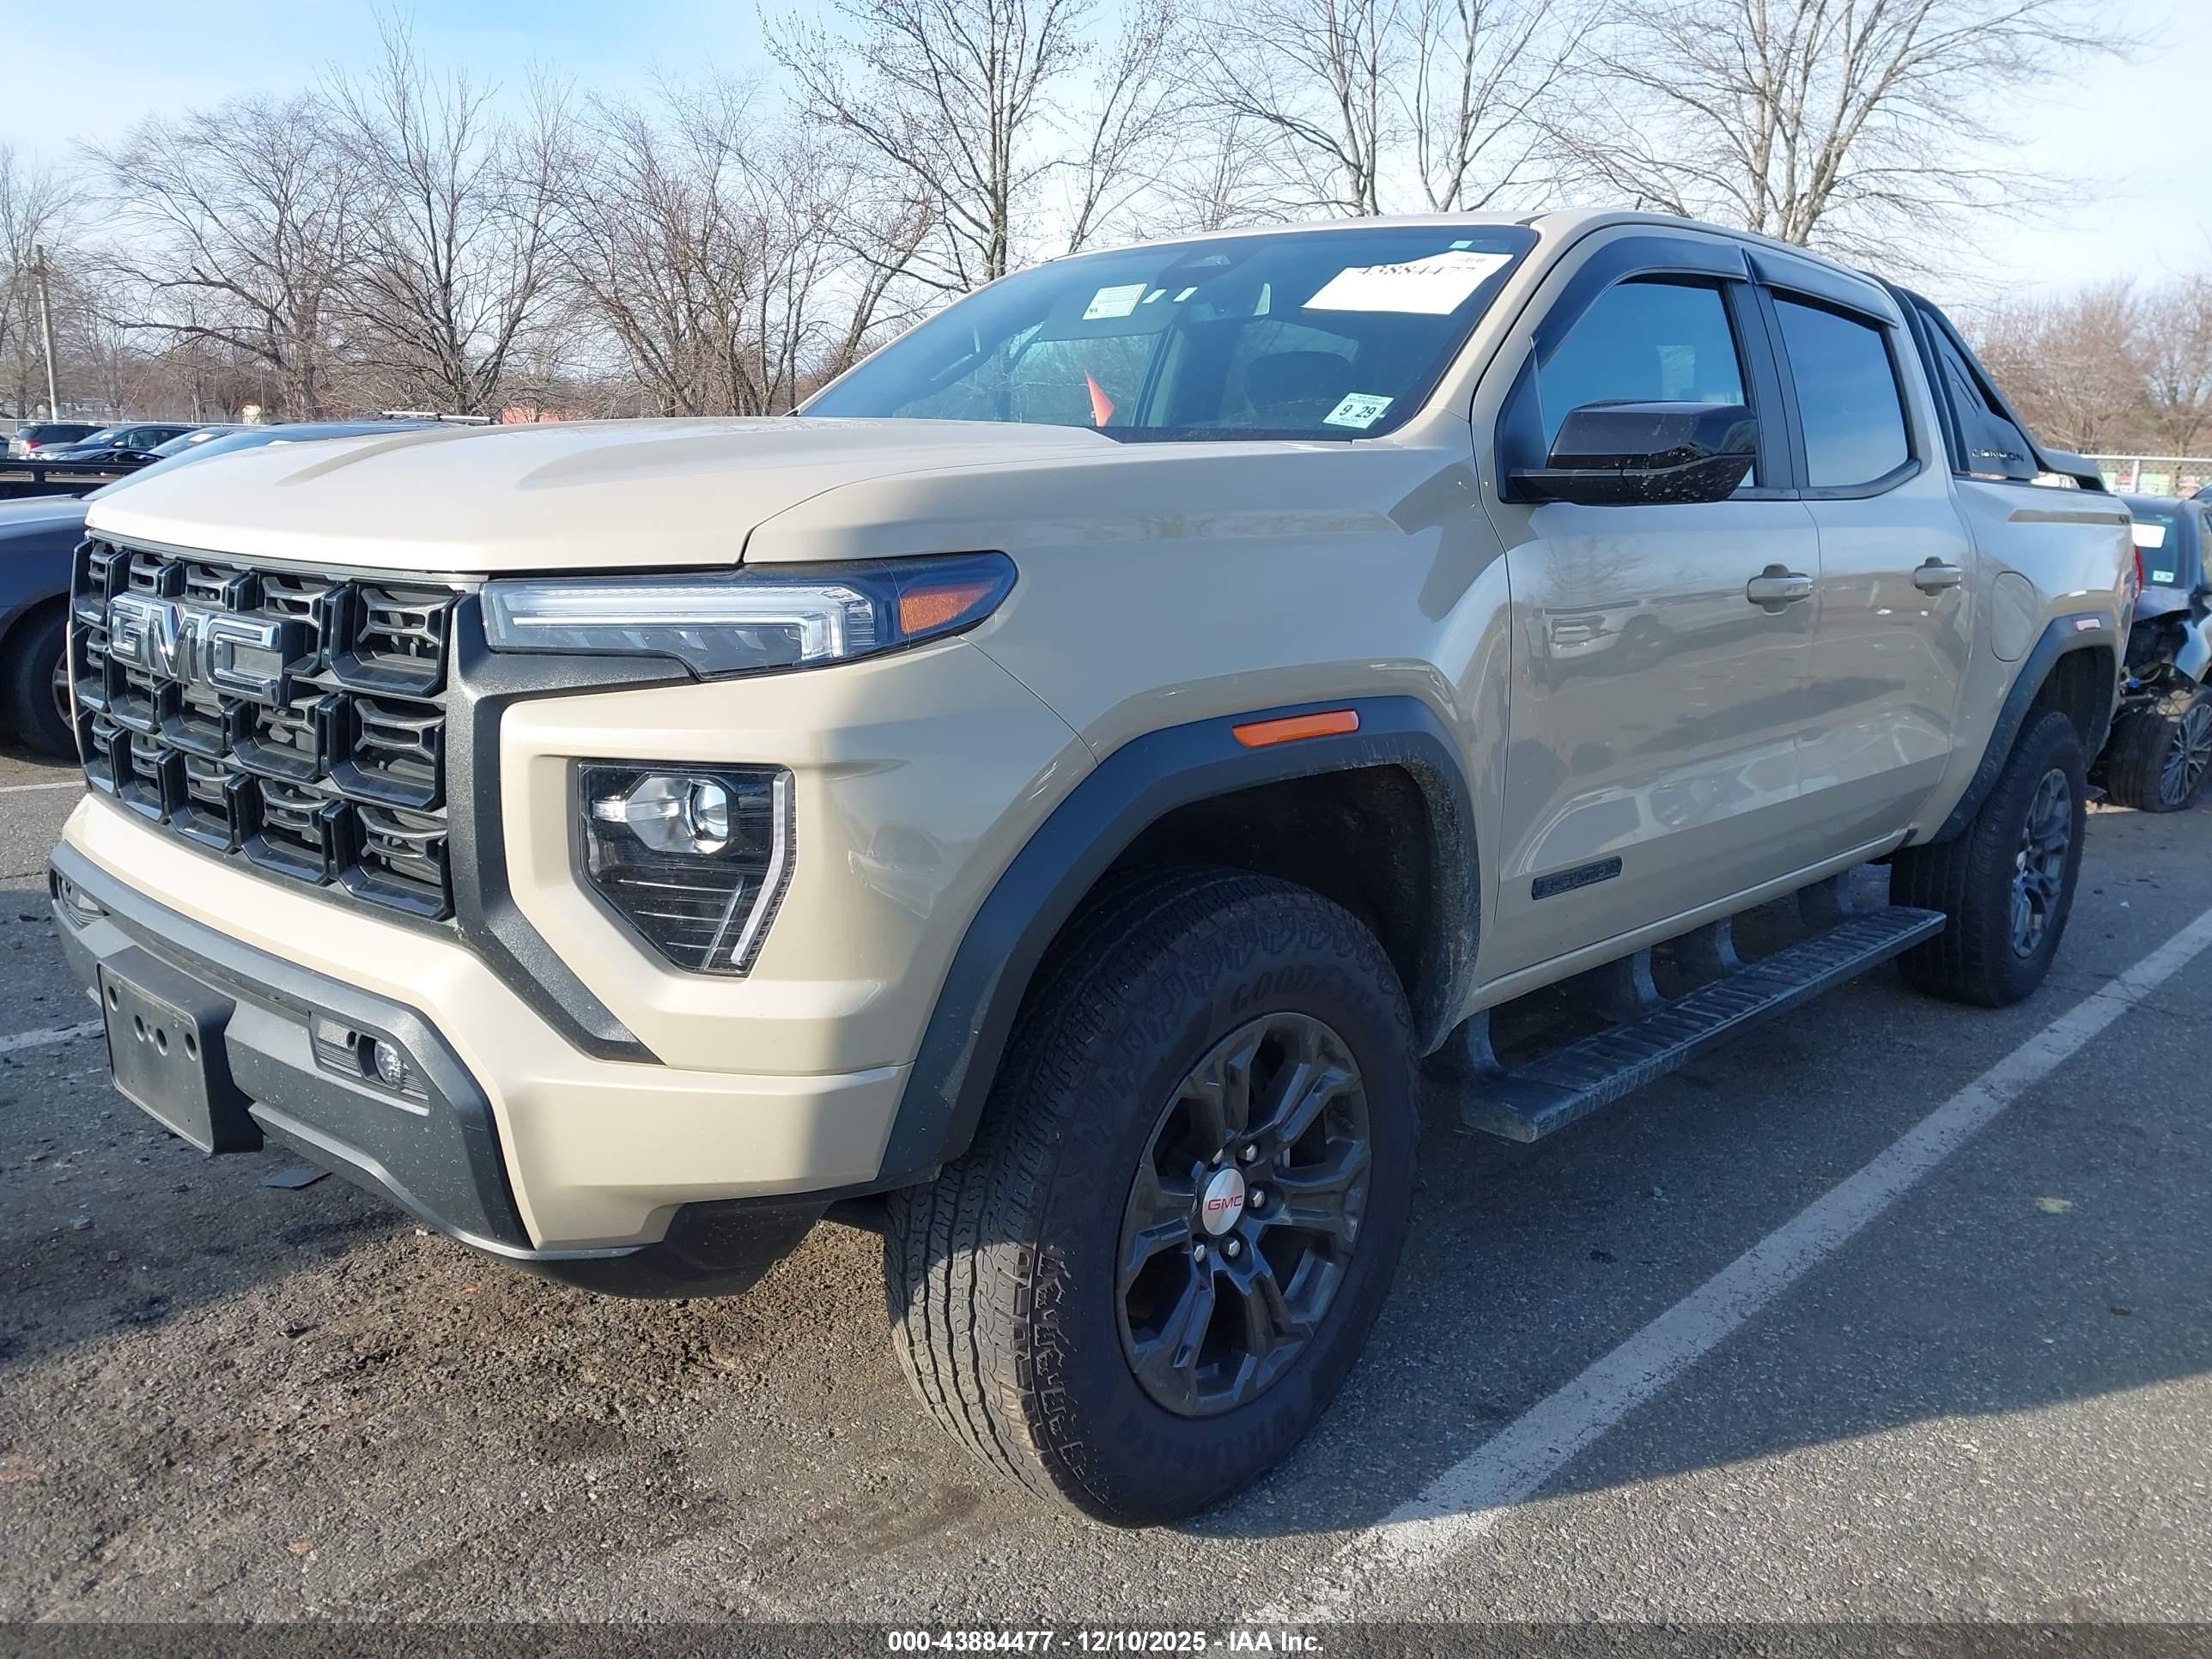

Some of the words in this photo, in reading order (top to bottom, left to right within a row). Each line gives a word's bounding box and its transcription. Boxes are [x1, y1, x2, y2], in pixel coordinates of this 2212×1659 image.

[1339, 404, 1353, 416] 9
[1354, 405, 1377, 419] 29
[107, 592, 282, 708] GMC
[1207, 1194, 1243, 1211] GMC
